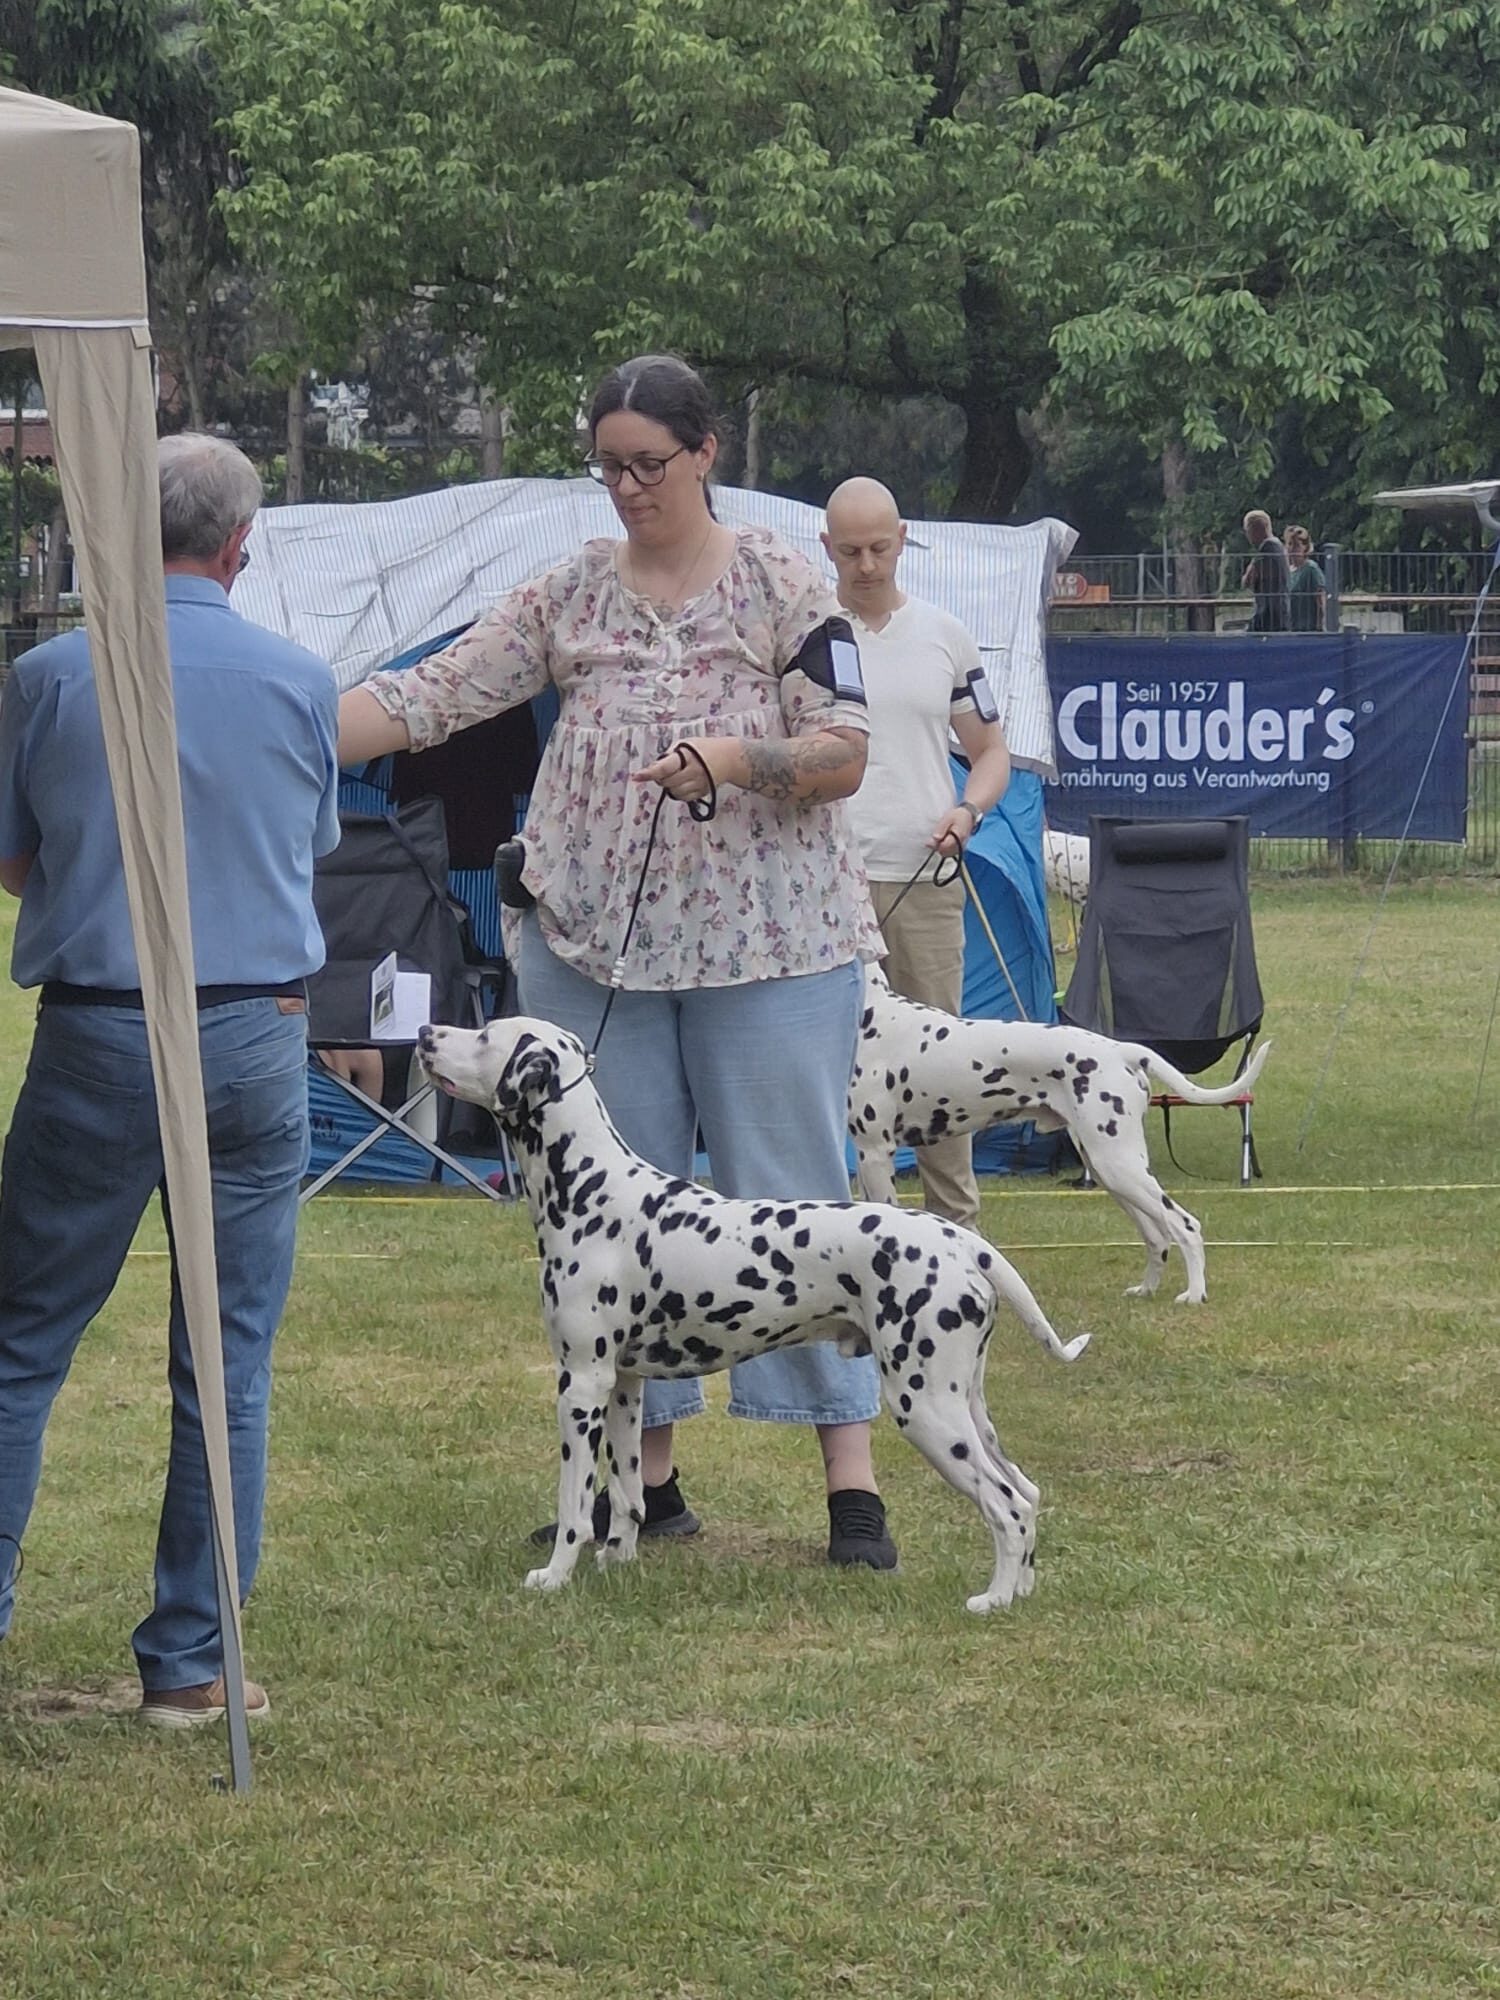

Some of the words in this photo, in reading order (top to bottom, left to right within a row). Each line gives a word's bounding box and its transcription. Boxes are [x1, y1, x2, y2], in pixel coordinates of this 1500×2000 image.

[1126, 681, 1160, 702] Seit
[1169, 681, 1219, 702] 1957
[1153, 772, 1187, 788] aus
[1192, 766, 1331, 793] Verantwortung
